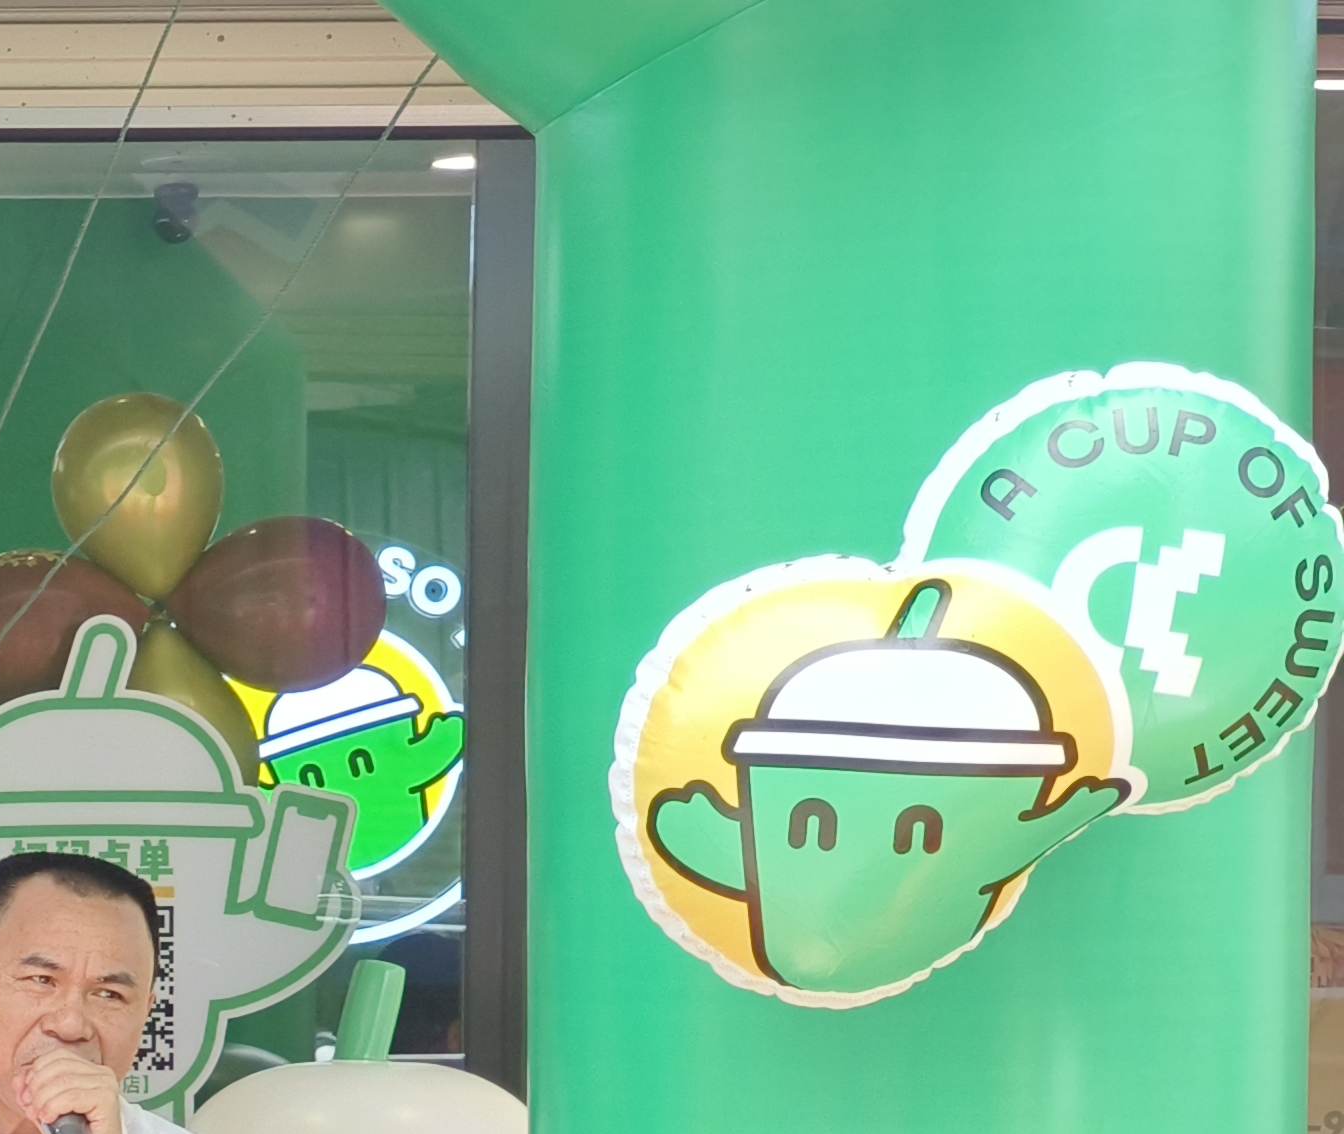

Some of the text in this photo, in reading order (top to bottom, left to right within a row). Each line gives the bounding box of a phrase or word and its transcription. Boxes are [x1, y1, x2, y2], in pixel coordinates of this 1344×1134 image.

[980, 406, 1336, 788] A CUP OF SWEET
